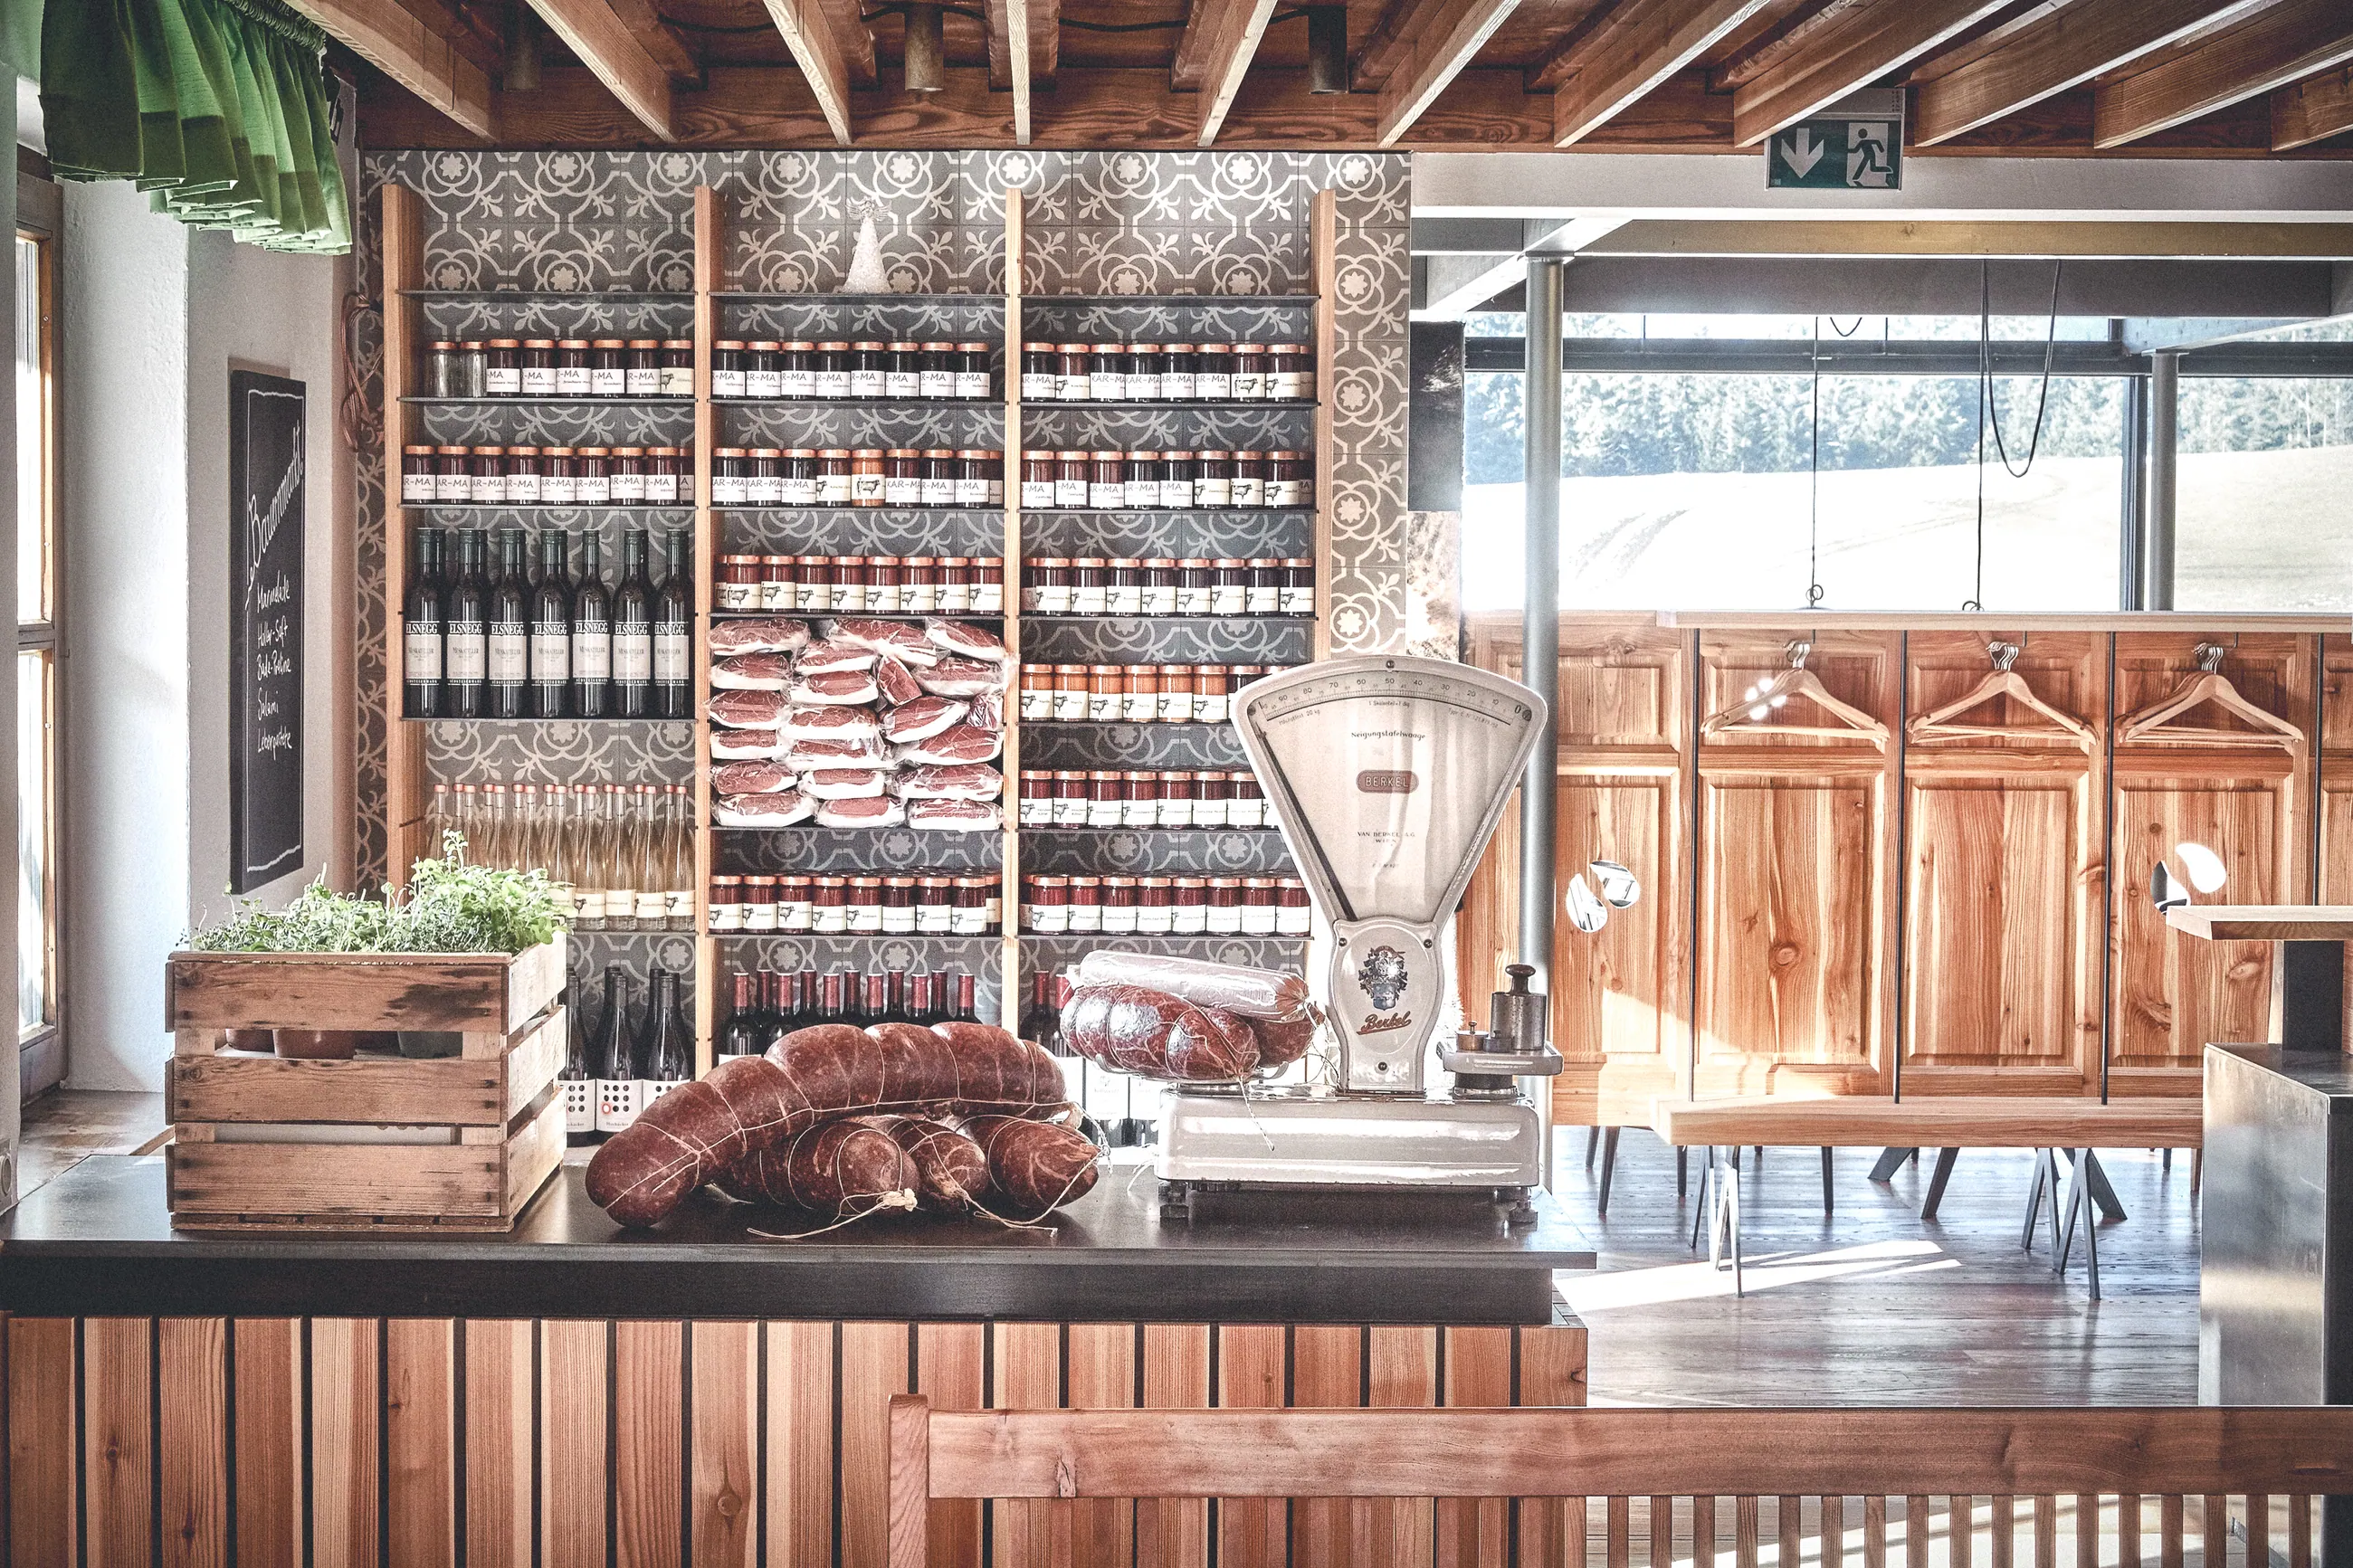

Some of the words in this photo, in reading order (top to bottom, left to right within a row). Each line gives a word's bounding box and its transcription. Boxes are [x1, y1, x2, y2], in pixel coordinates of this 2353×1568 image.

[406, 623, 438, 634] ELSNEGG
[450, 623, 482, 634] ELSNEGG
[491, 624, 524, 635] ELSNEGG
[535, 624, 567, 635] ELSNEGG
[576, 622, 608, 633] ELSNEGG
[615, 624, 648, 635] ELSNEGG
[1514, 705, 1521, 714] 0
[1351, 730, 1425, 741] Neigungstafelwaage
[1366, 776, 1409, 787] BERKEL
[1358, 1011, 1412, 1034] Berkel
